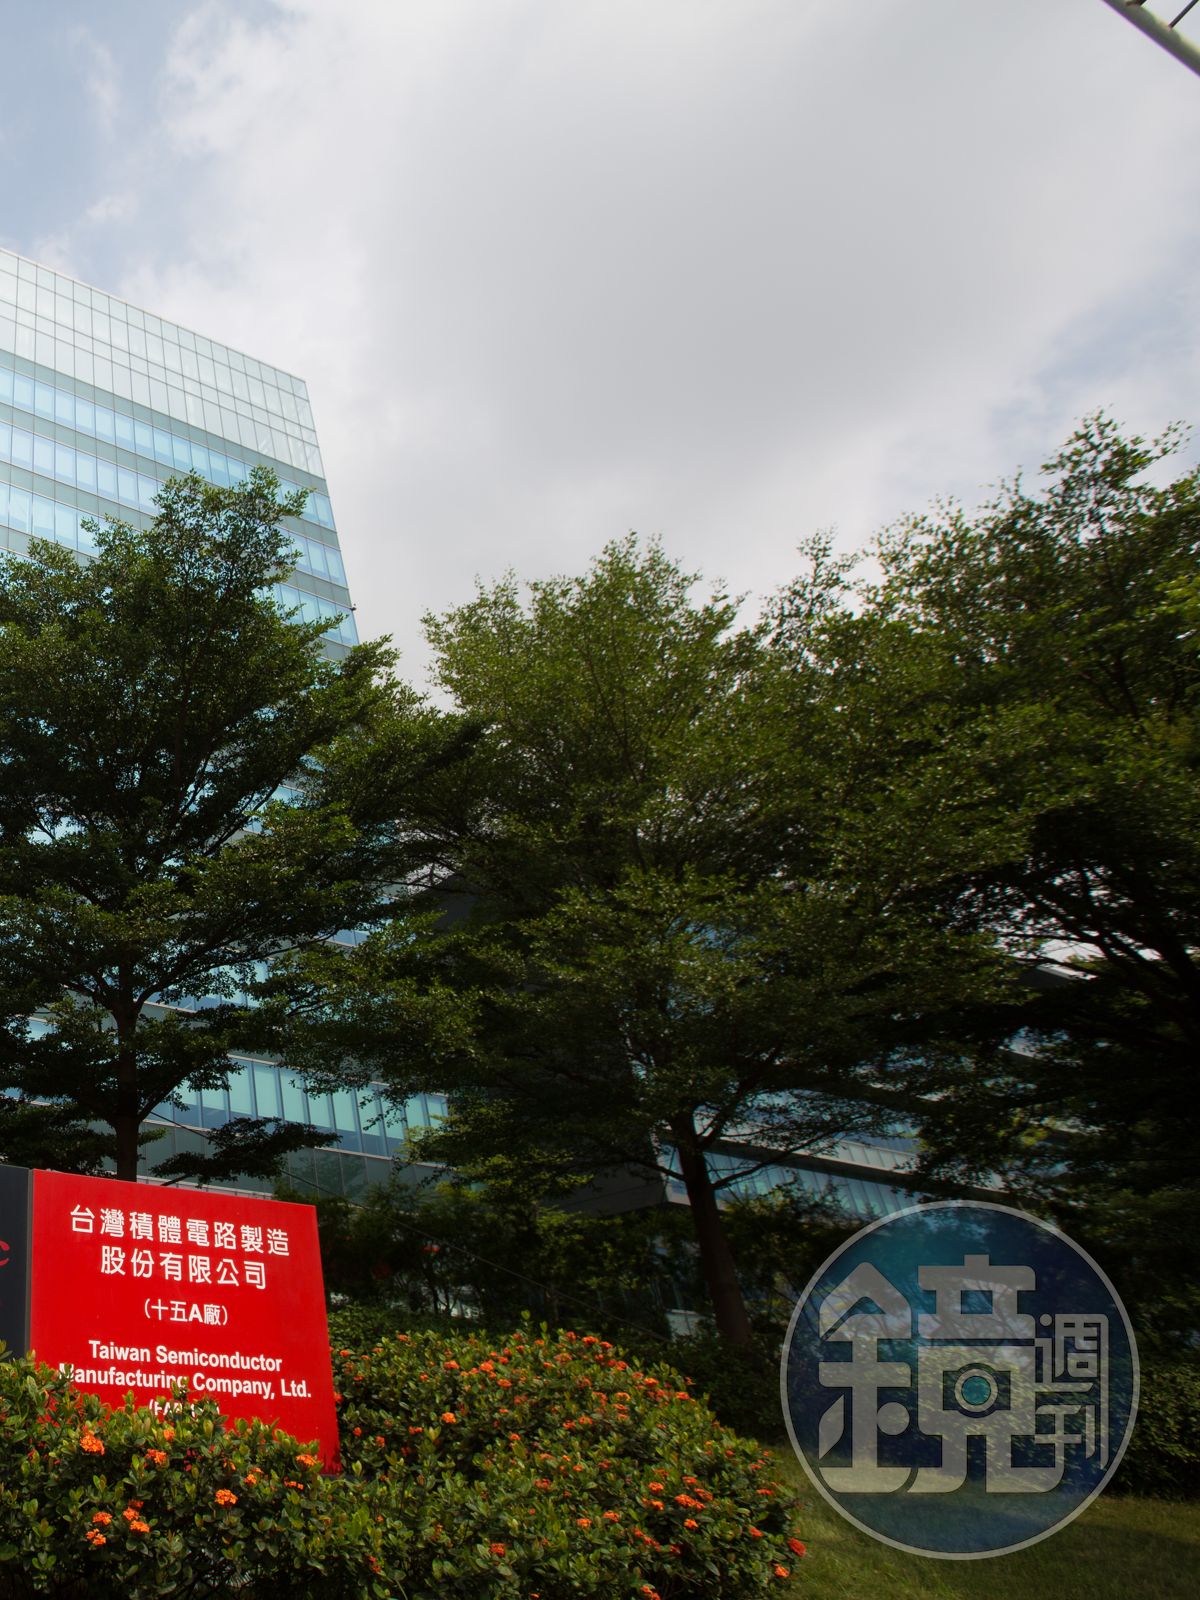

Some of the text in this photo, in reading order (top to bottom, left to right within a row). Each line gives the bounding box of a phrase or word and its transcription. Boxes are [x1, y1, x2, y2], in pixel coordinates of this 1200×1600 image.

[70, 1204, 290, 1257] 台灣積體電路製造
[100, 1245, 267, 1290] 股份有限公司
[88, 1339, 283, 1372] Taiwan Semiconductor
[192, 1372, 275, 1400] Company,
[280, 1378, 312, 1398] Ltd.
